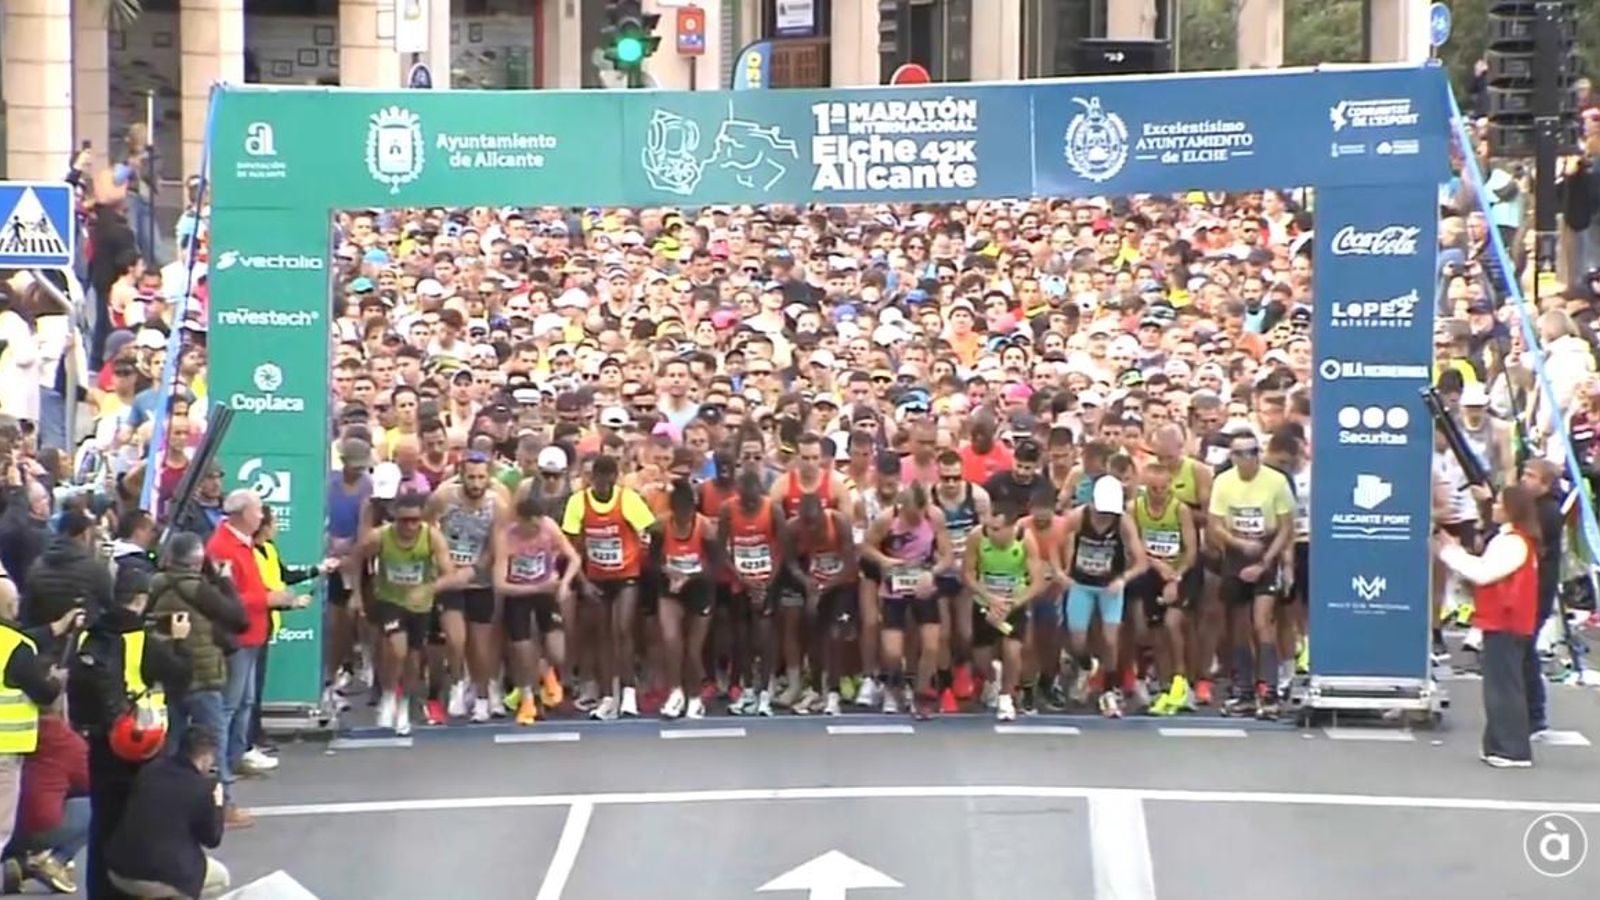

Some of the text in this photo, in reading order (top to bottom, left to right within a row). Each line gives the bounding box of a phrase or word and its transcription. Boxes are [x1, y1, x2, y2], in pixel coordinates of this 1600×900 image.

[848, 96, 978, 121] MARATÓN
[848, 119, 978, 134] INTERNACIONAL
[1143, 120, 1245, 136] Excelentísimo
[436, 133, 557, 152] Ayuntamiento
[812, 134, 978, 165] Elche 42K
[1135, 133, 1254, 150] AYUNTAMIENTO
[449, 151, 544, 167] de Alicante
[1161, 148, 1229, 163] de ELCHE
[811, 157, 978, 191] Alicante
[1332, 302, 1413, 318] LOPEZ
[231, 394, 304, 414] Coplaca
[1339, 430, 1408, 445] Securitas
[1332, 513, 1411, 525] ALICANTE PORT
[279, 628, 314, 641] Sport
